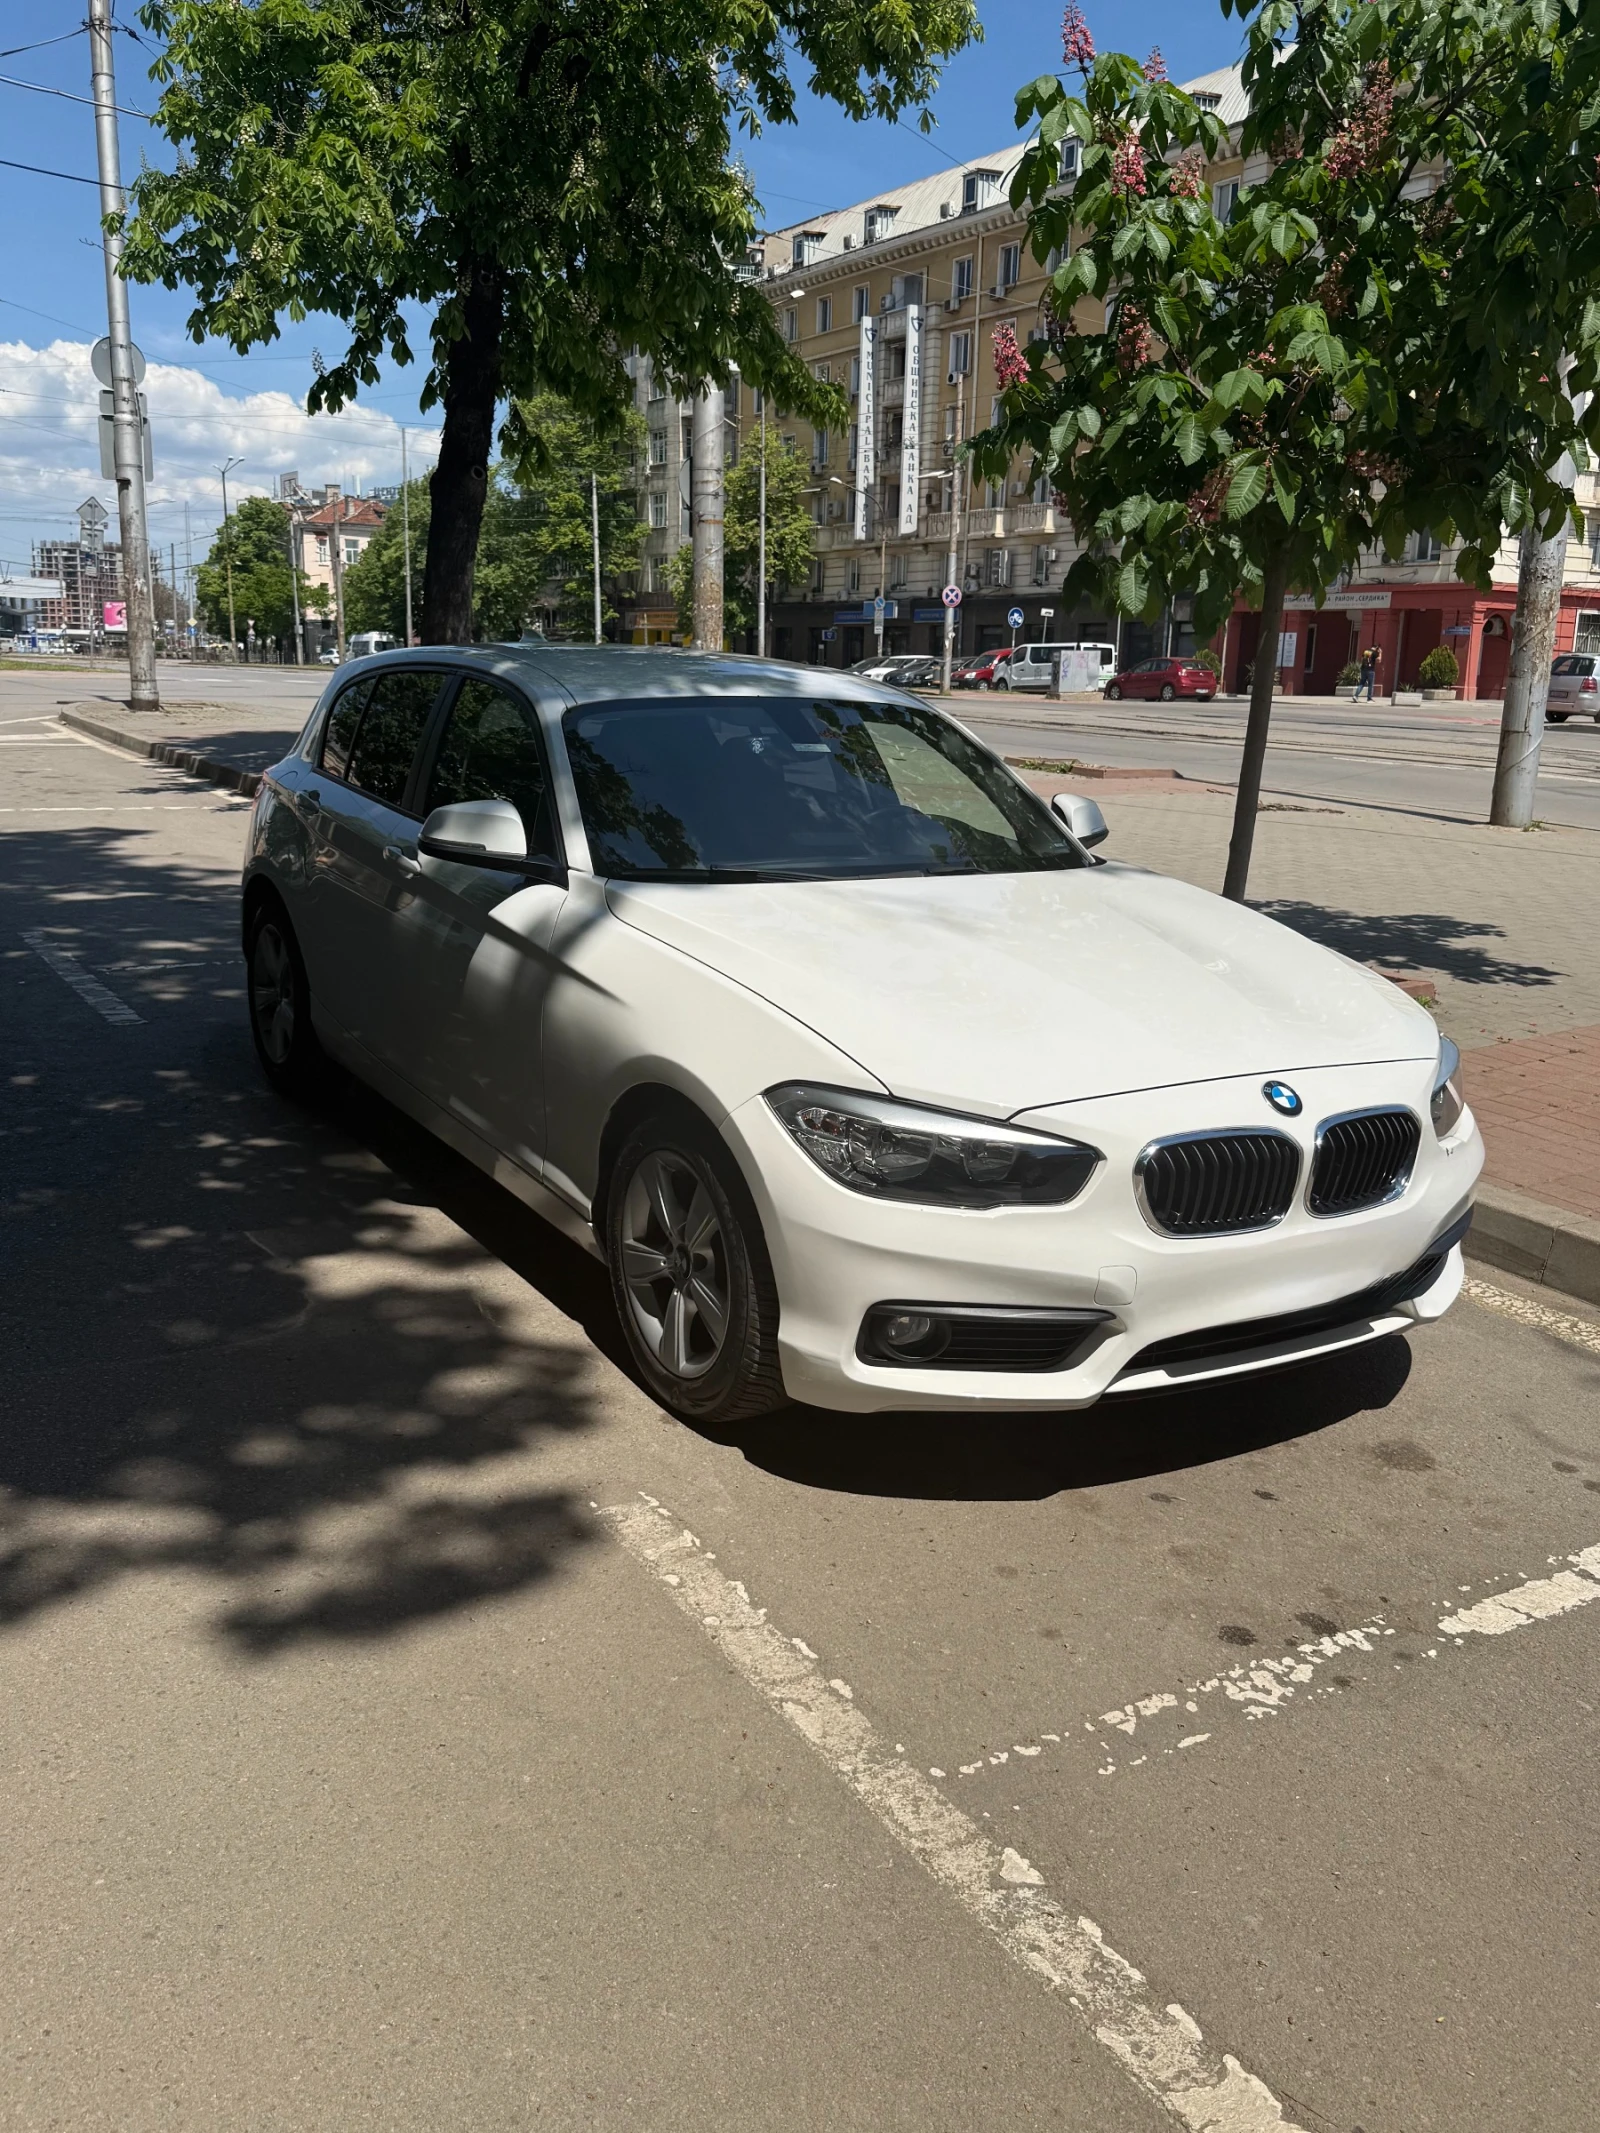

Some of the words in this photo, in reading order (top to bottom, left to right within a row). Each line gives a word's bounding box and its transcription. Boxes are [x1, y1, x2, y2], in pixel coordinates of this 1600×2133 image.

[864, 350, 874, 446] MUNICIPAL
[909, 345, 920, 432] ОБЩИНСКА
[905, 504, 913, 525] АД
